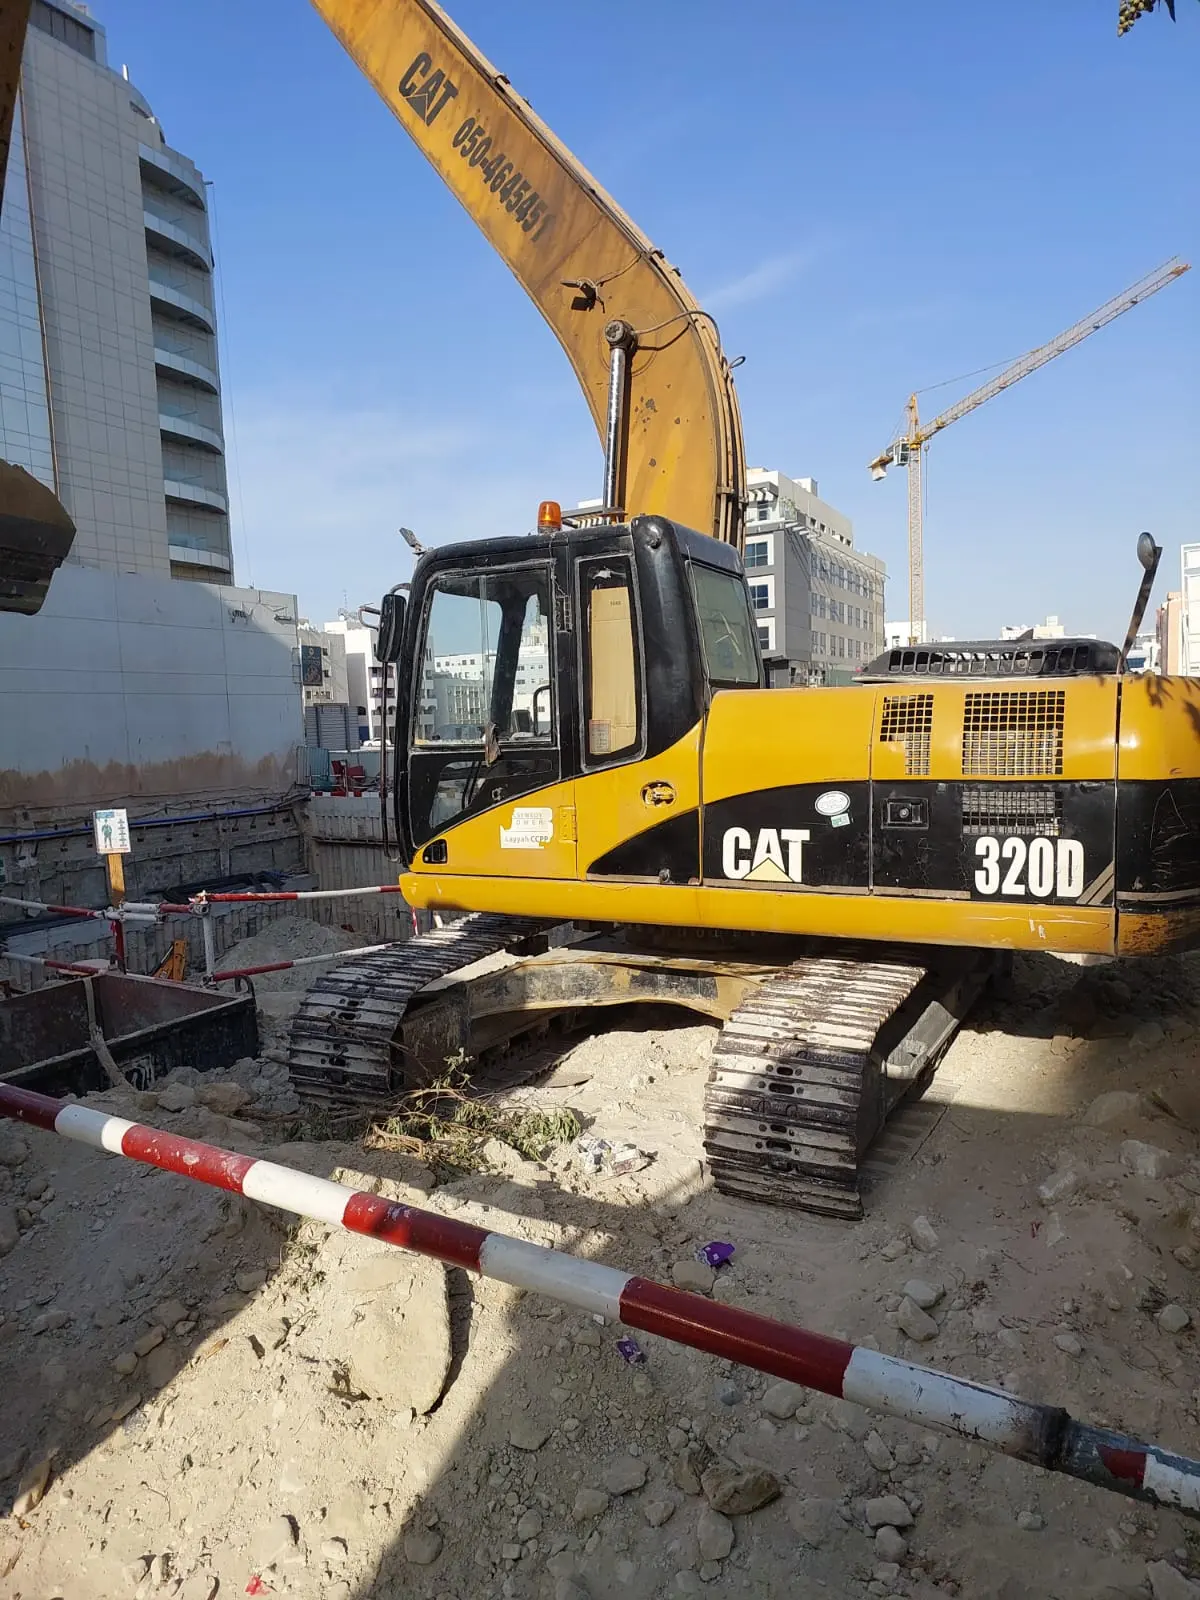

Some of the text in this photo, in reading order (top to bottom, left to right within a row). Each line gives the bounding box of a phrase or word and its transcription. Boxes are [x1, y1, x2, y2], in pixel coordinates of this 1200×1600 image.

[398, 52, 459, 127] CAT
[722, 826, 811, 883] CAT
[974, 836, 1085, 899] 320D
